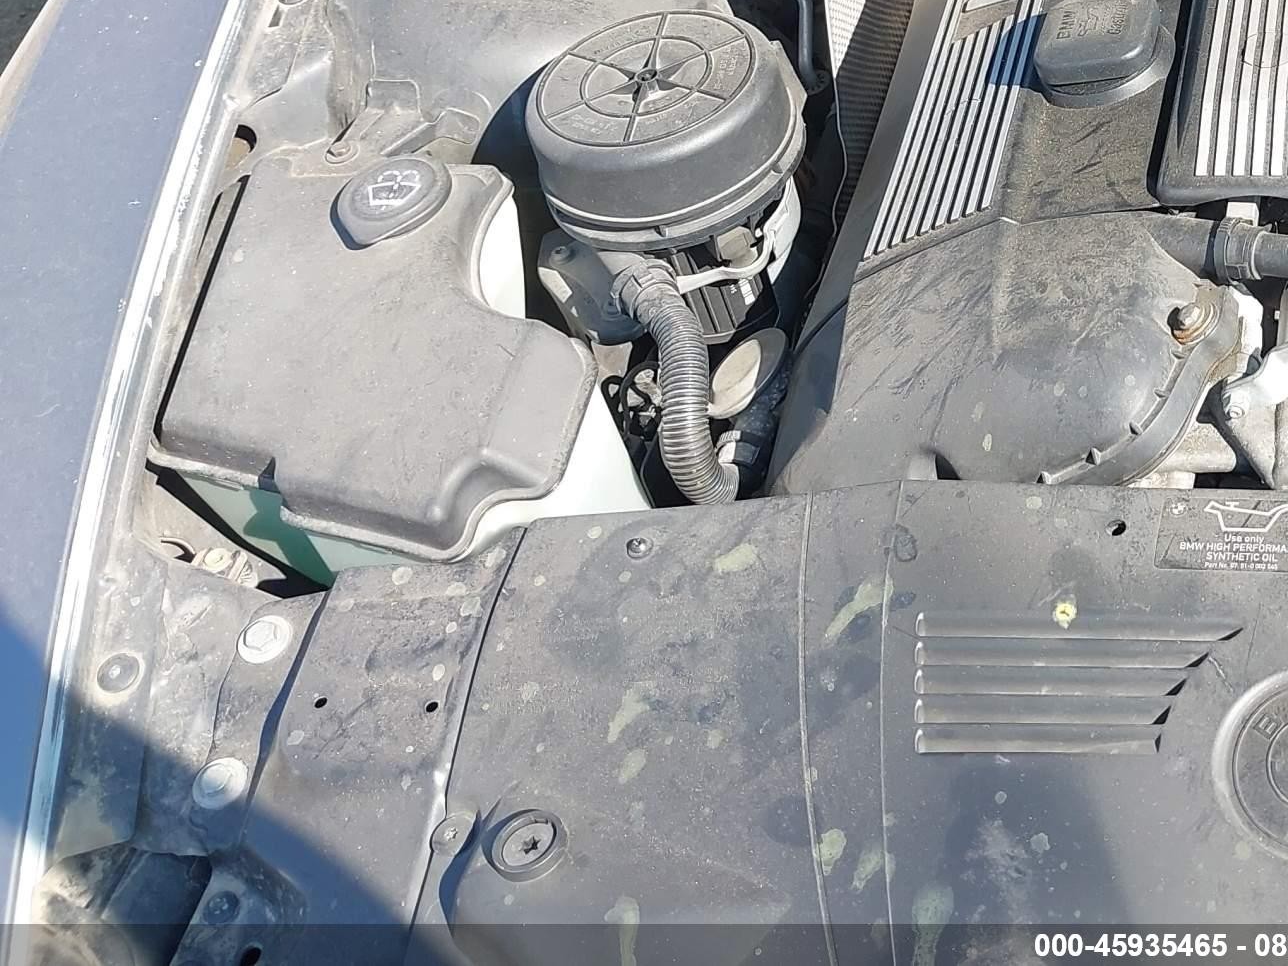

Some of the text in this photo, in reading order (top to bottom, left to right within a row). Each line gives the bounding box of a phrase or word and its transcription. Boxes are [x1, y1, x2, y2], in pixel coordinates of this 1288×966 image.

[1056, 10, 1076, 39] BMW
[1224, 533, 1265, 544] Use only
[1179, 541, 1205, 551] BMW
[1206, 542, 1230, 551] HIGH
[1206, 551, 1278, 562] SYNTHETIC OIL
